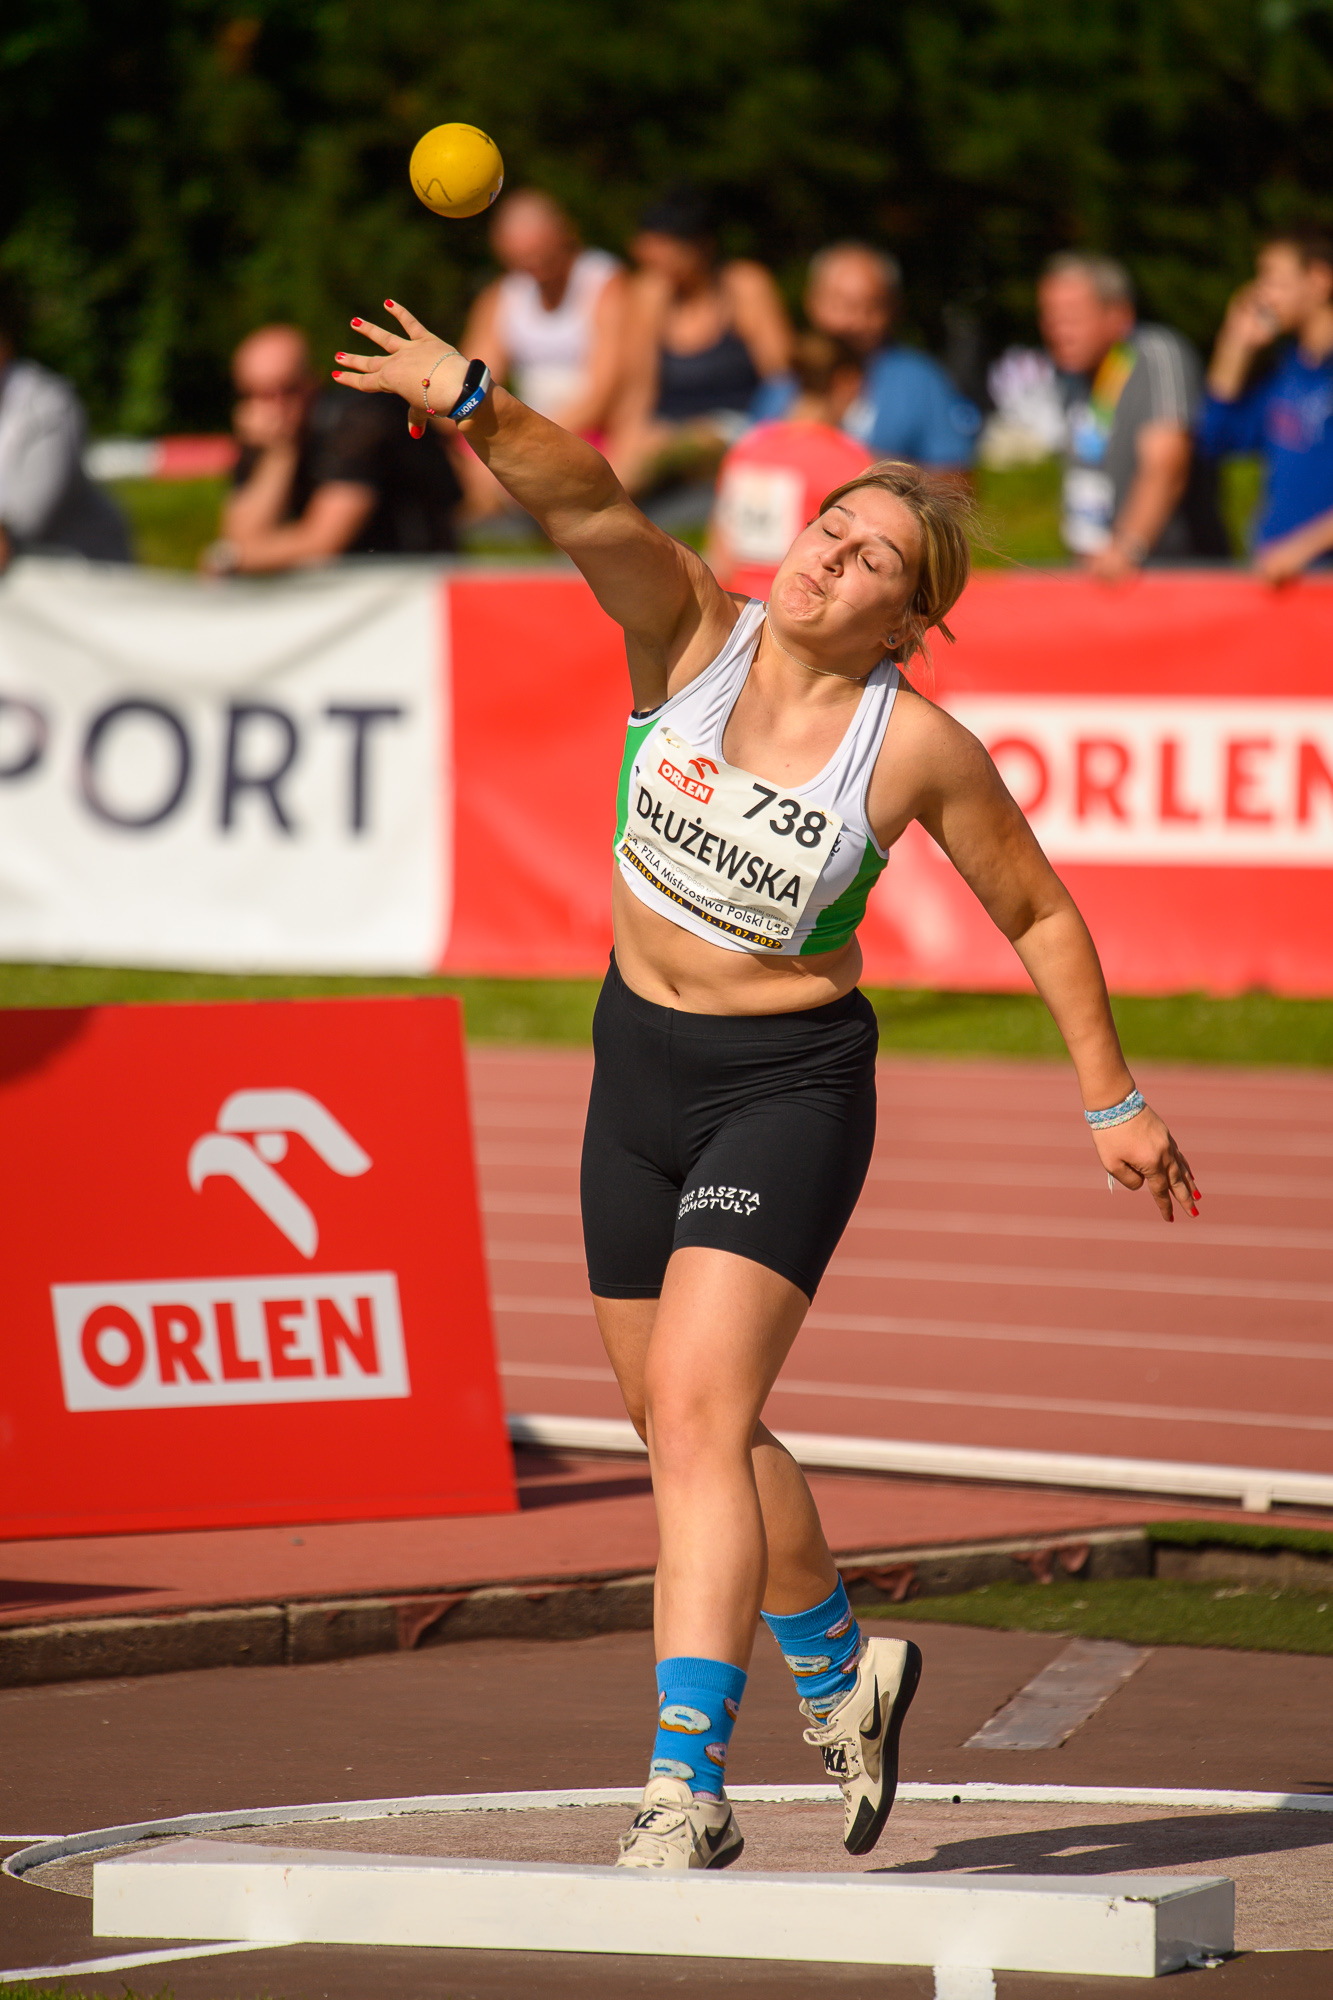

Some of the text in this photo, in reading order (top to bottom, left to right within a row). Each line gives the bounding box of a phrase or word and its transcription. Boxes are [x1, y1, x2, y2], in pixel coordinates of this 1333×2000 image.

[661, 764, 710, 802] ORLEN
[742, 782, 827, 848] 738
[637, 786, 801, 908] DŁUŻEWSKA
[641, 845, 661, 871] PZLA
[661, 867, 723, 913] Mistrzostwa
[726, 905, 764, 928] Polski
[622, 847, 683, 905] BIELSKO-BIAŁA
[701, 911, 781, 949] 15-17.07.2022
[697, 1185, 761, 1206] BASZTA
[80, 1295, 384, 1391] ORLEN
